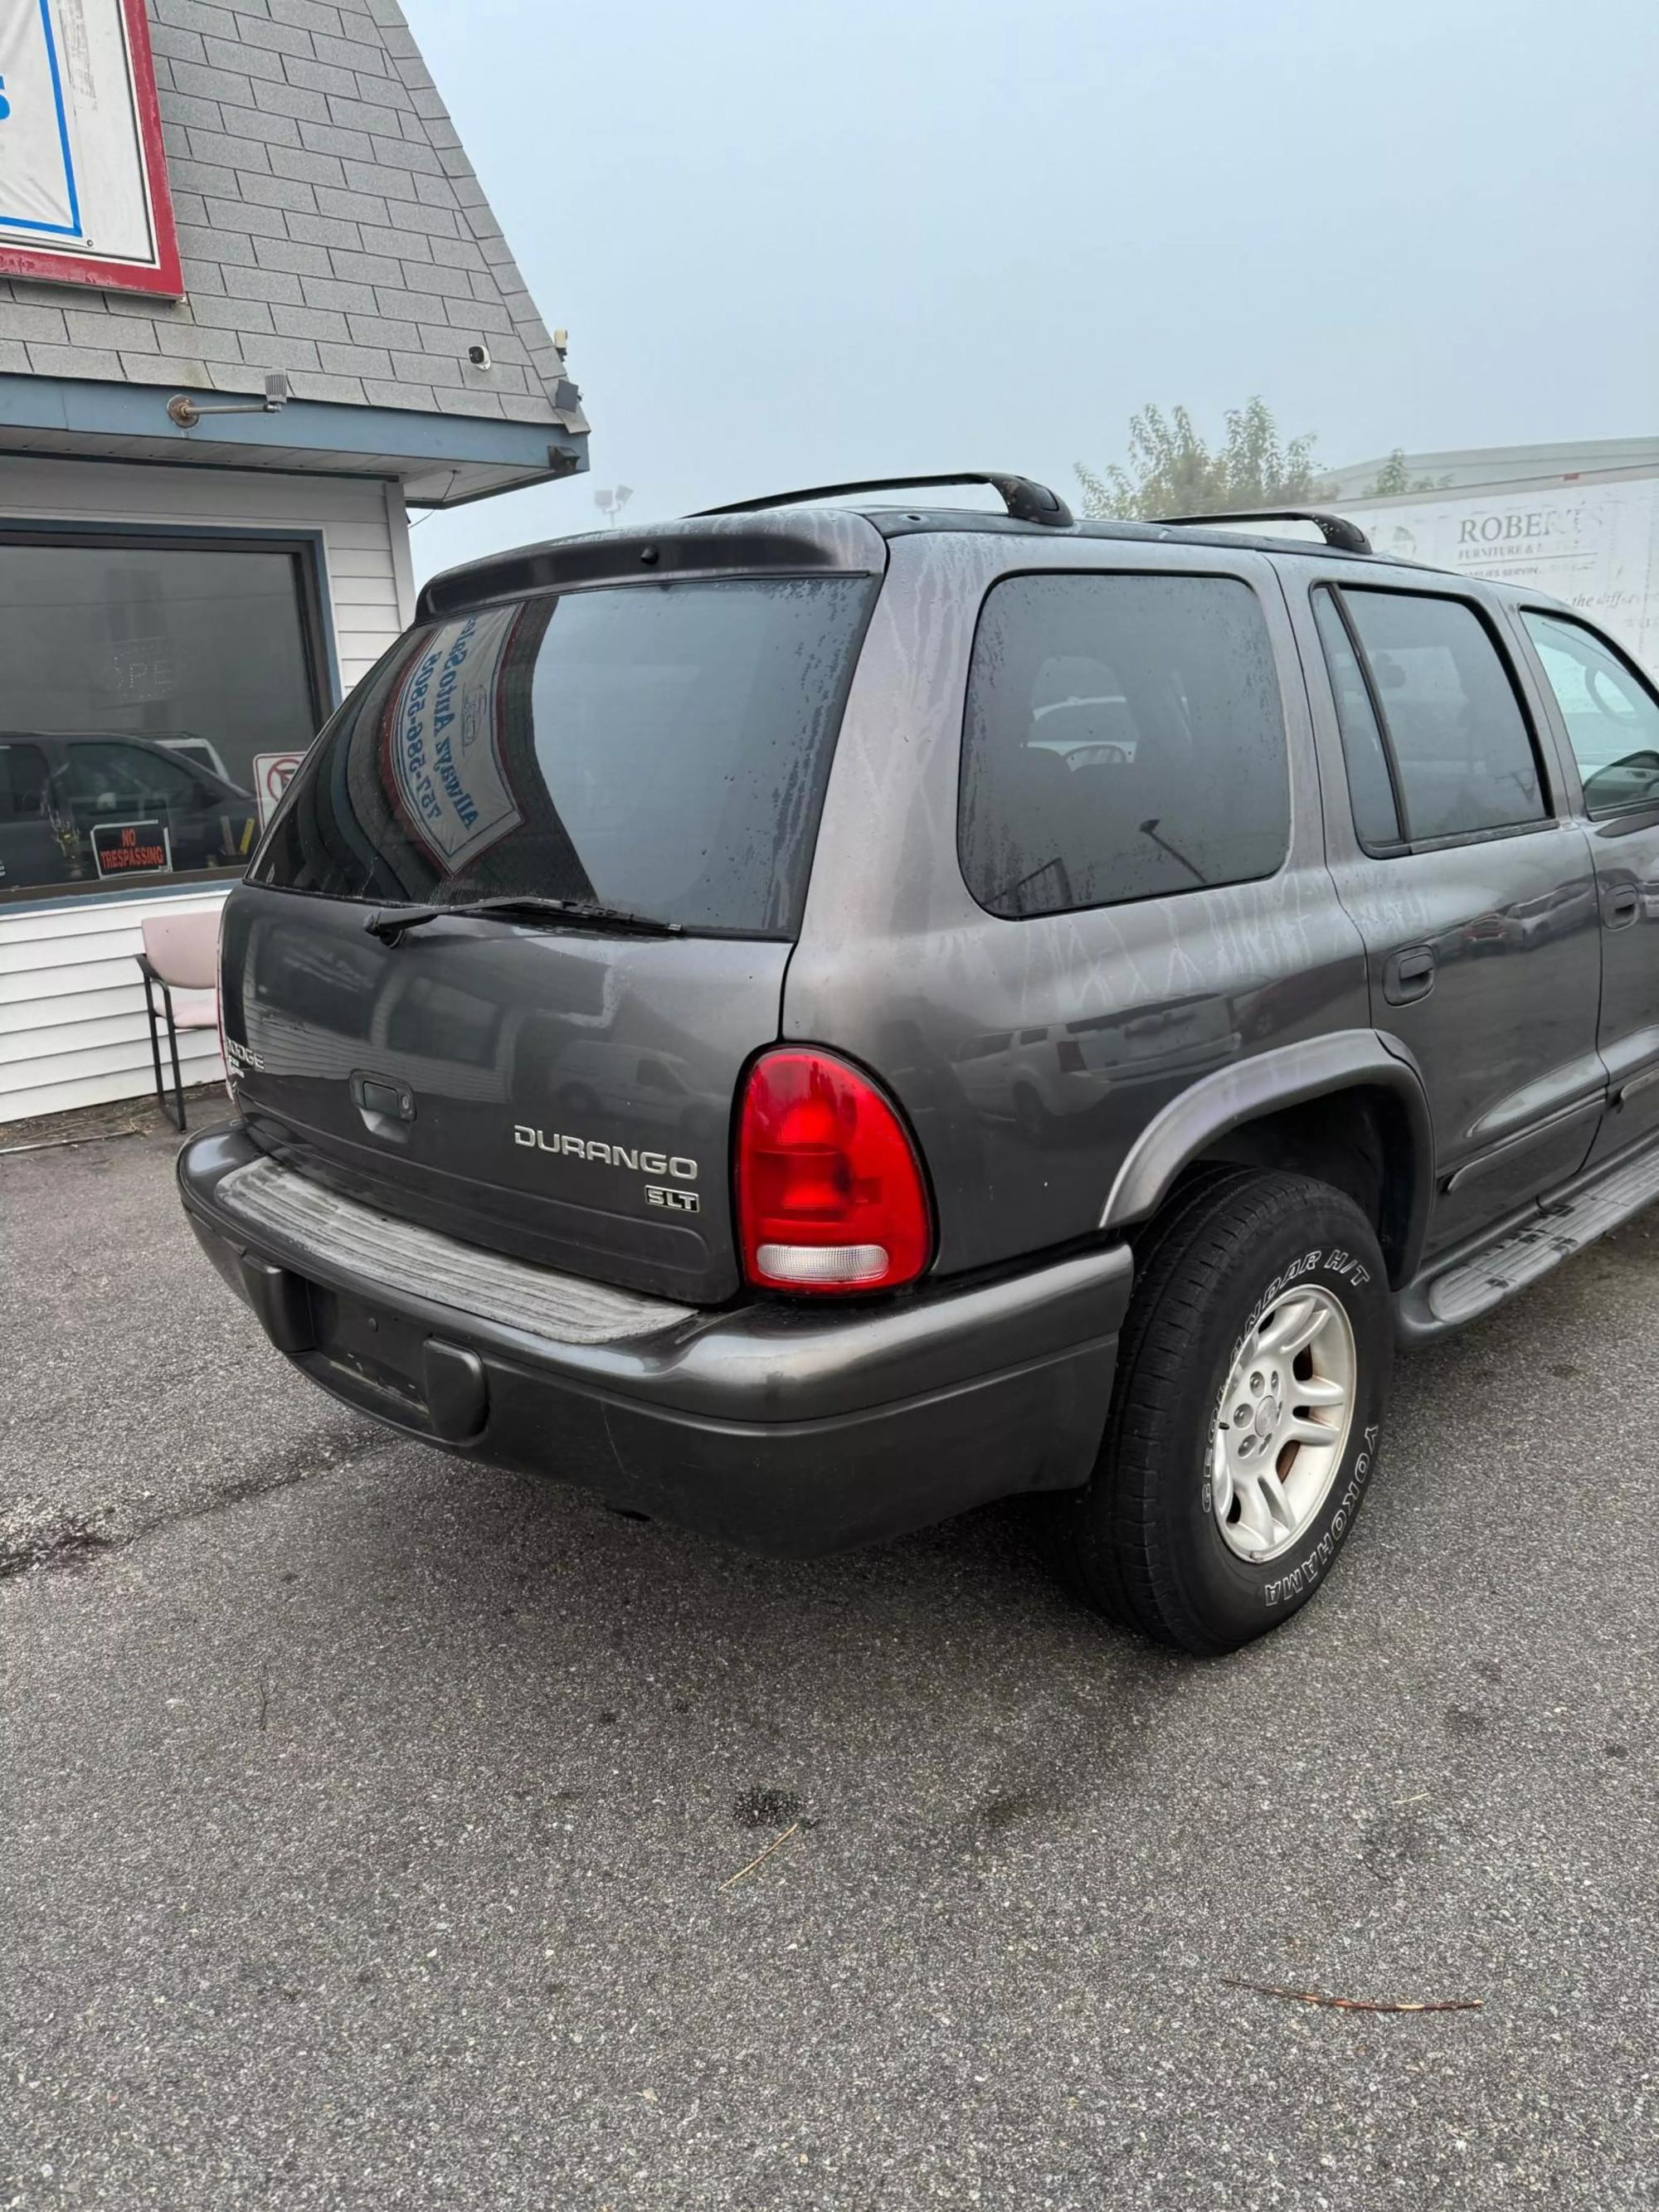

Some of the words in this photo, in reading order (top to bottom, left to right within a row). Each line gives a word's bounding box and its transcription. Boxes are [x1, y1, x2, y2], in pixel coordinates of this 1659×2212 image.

[1502, 566, 1542, 577] SERVIN
[121, 829, 136, 847] NO
[100, 846, 164, 870] TRESPASSING
[513, 1125, 698, 1180] DURANGO
[647, 1189, 696, 1209] SLT
[1323, 1249, 1370, 1286] H/T
[1264, 1425, 1379, 1607] YOKOHAMA
